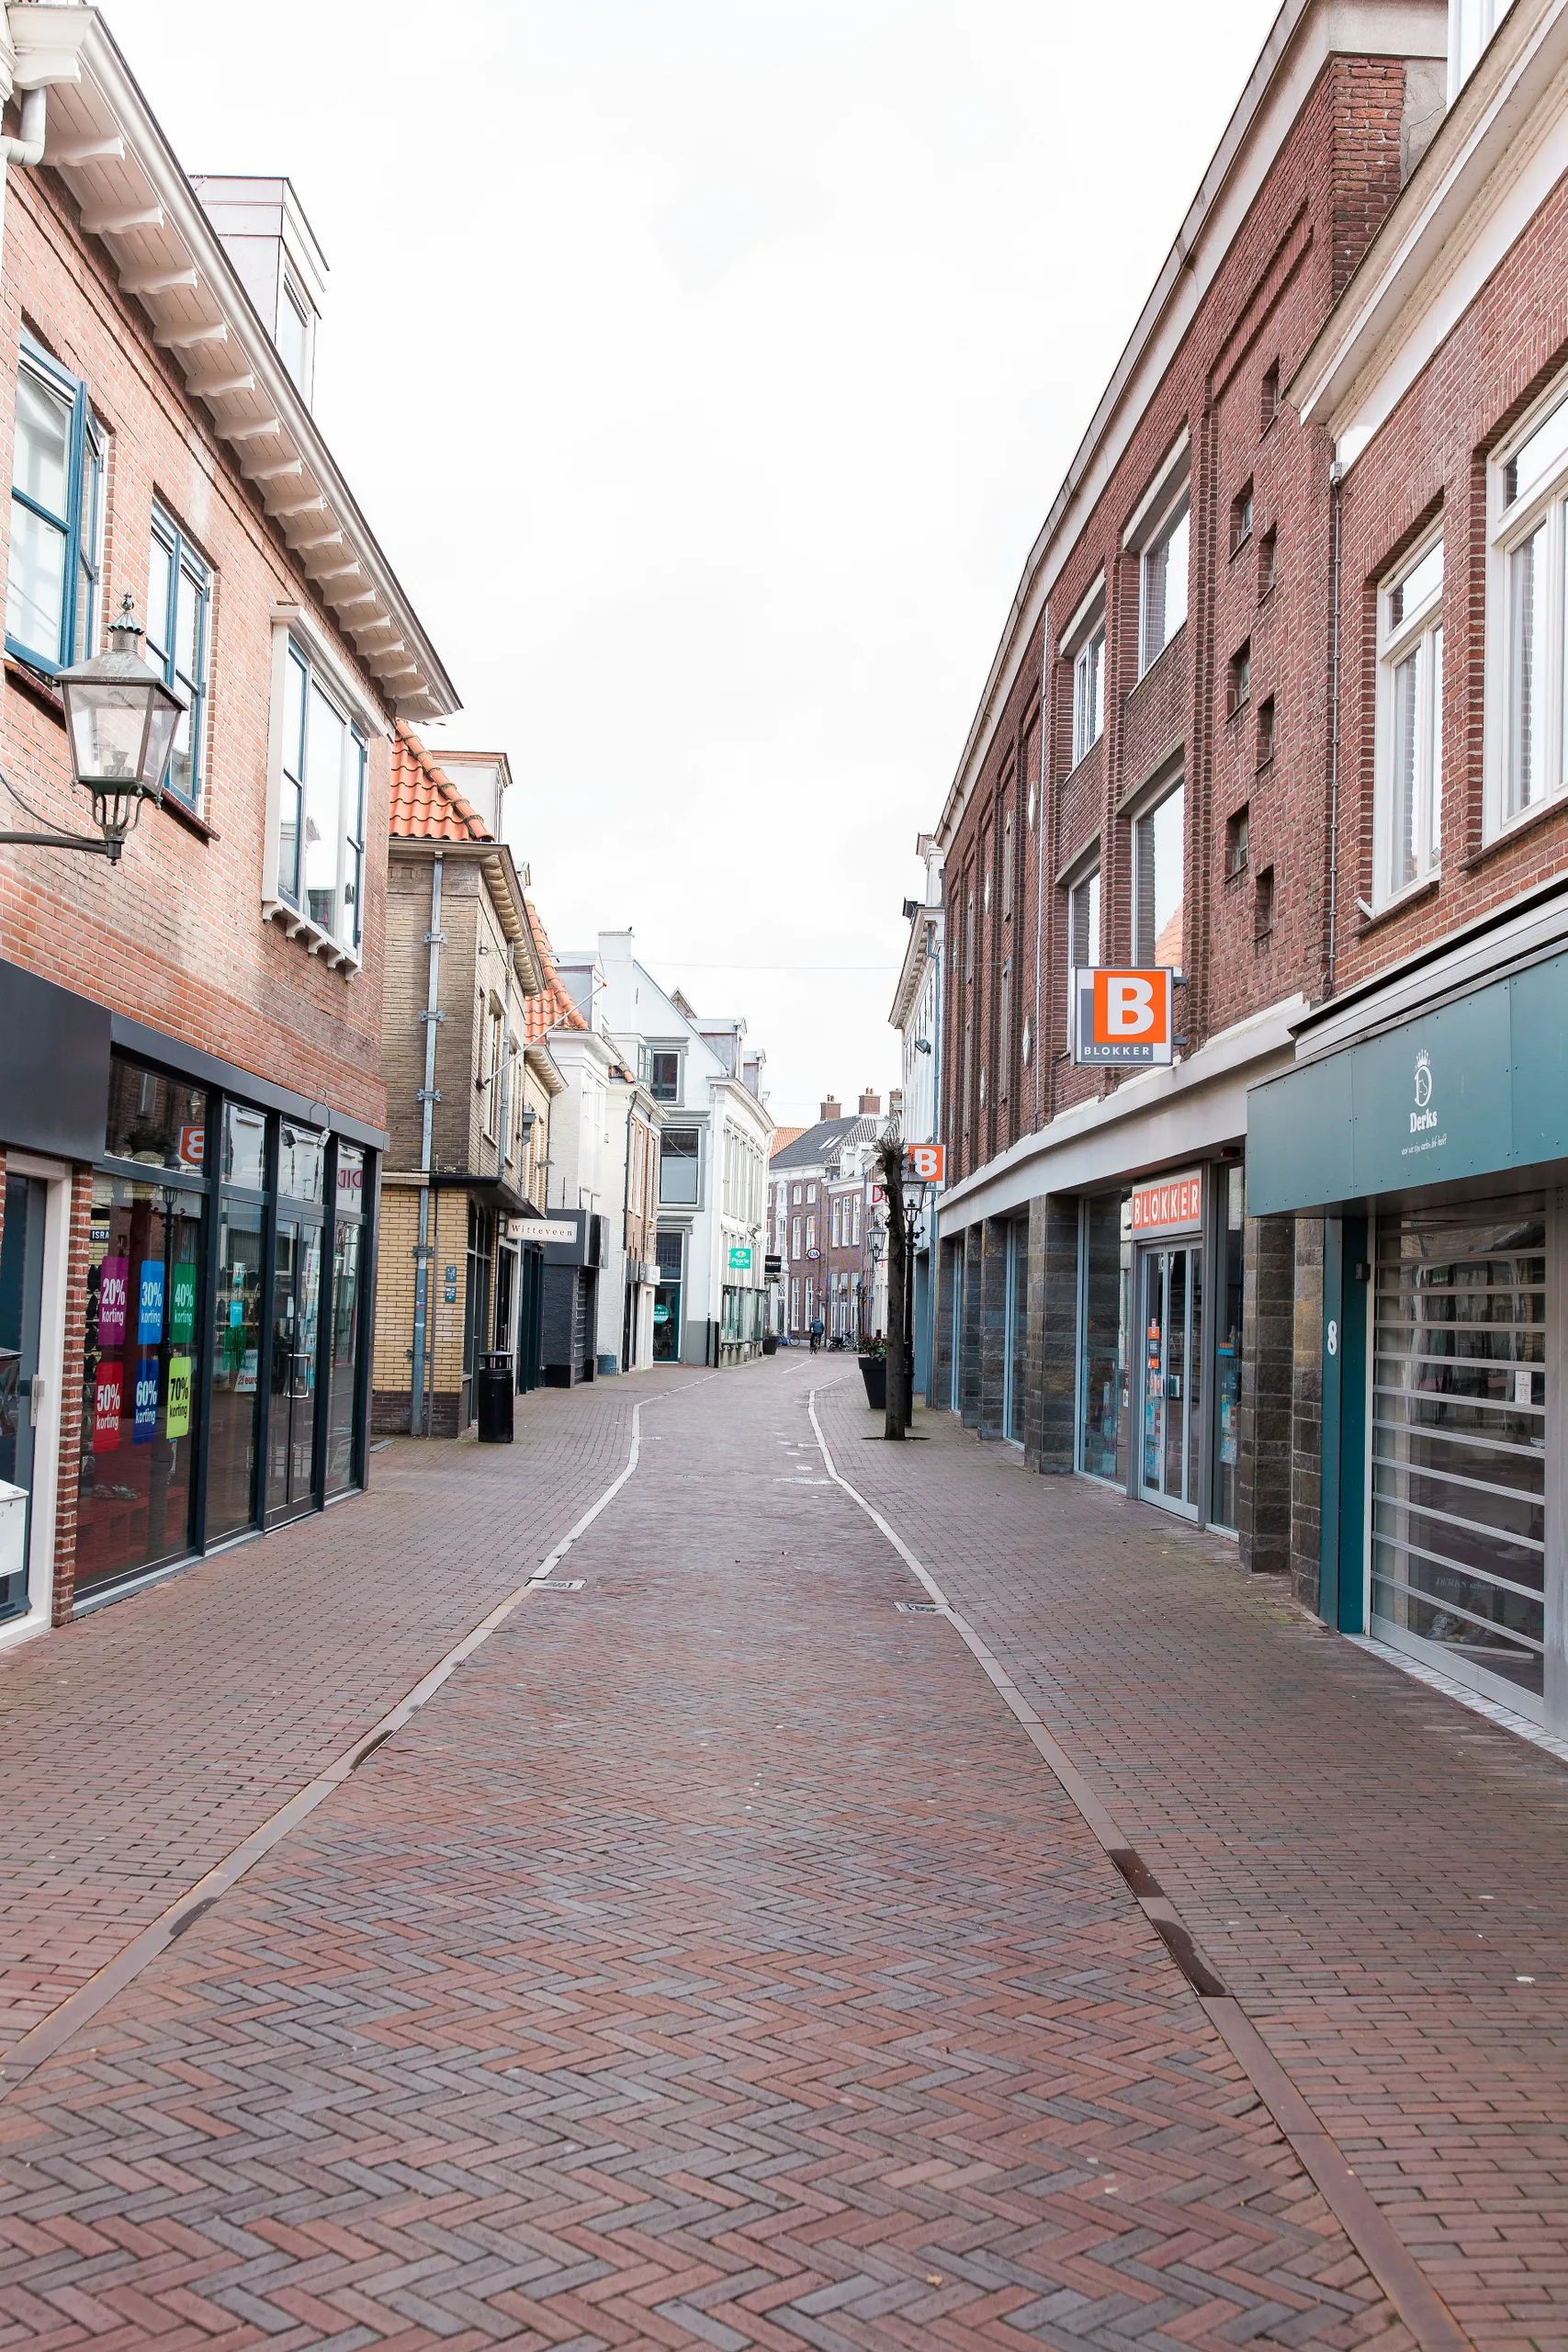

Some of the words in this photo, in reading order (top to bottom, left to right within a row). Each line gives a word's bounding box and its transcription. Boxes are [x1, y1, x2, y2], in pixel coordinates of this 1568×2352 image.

[1107, 977, 1155, 1035] B
[1084, 1046, 1150, 1056] BLOKKER
[1409, 1108, 1438, 1134] Derks
[915, 1148, 937, 1177] B
[1134, 1184, 1199, 1225] BLOKKER
[511, 1224, 572, 1237] Witteveen
[102, 1278, 125, 1306] 20%
[141, 1282, 162, 1307] 30%
[175, 1283, 194, 1307] 40%
[101, 1307, 124, 1326] korting
[141, 1309, 161, 1327] korting
[174, 1309, 193, 1327] korting
[1327, 1320, 1337, 1356] 8
[96, 1384, 120, 1411] 50%
[136, 1380, 157, 1407] 60%
[170, 1376, 188, 1402] 70%
[96, 1413, 118, 1430] korting
[135, 1408, 155, 1425] korting
[169, 1404, 187, 1419] korting
